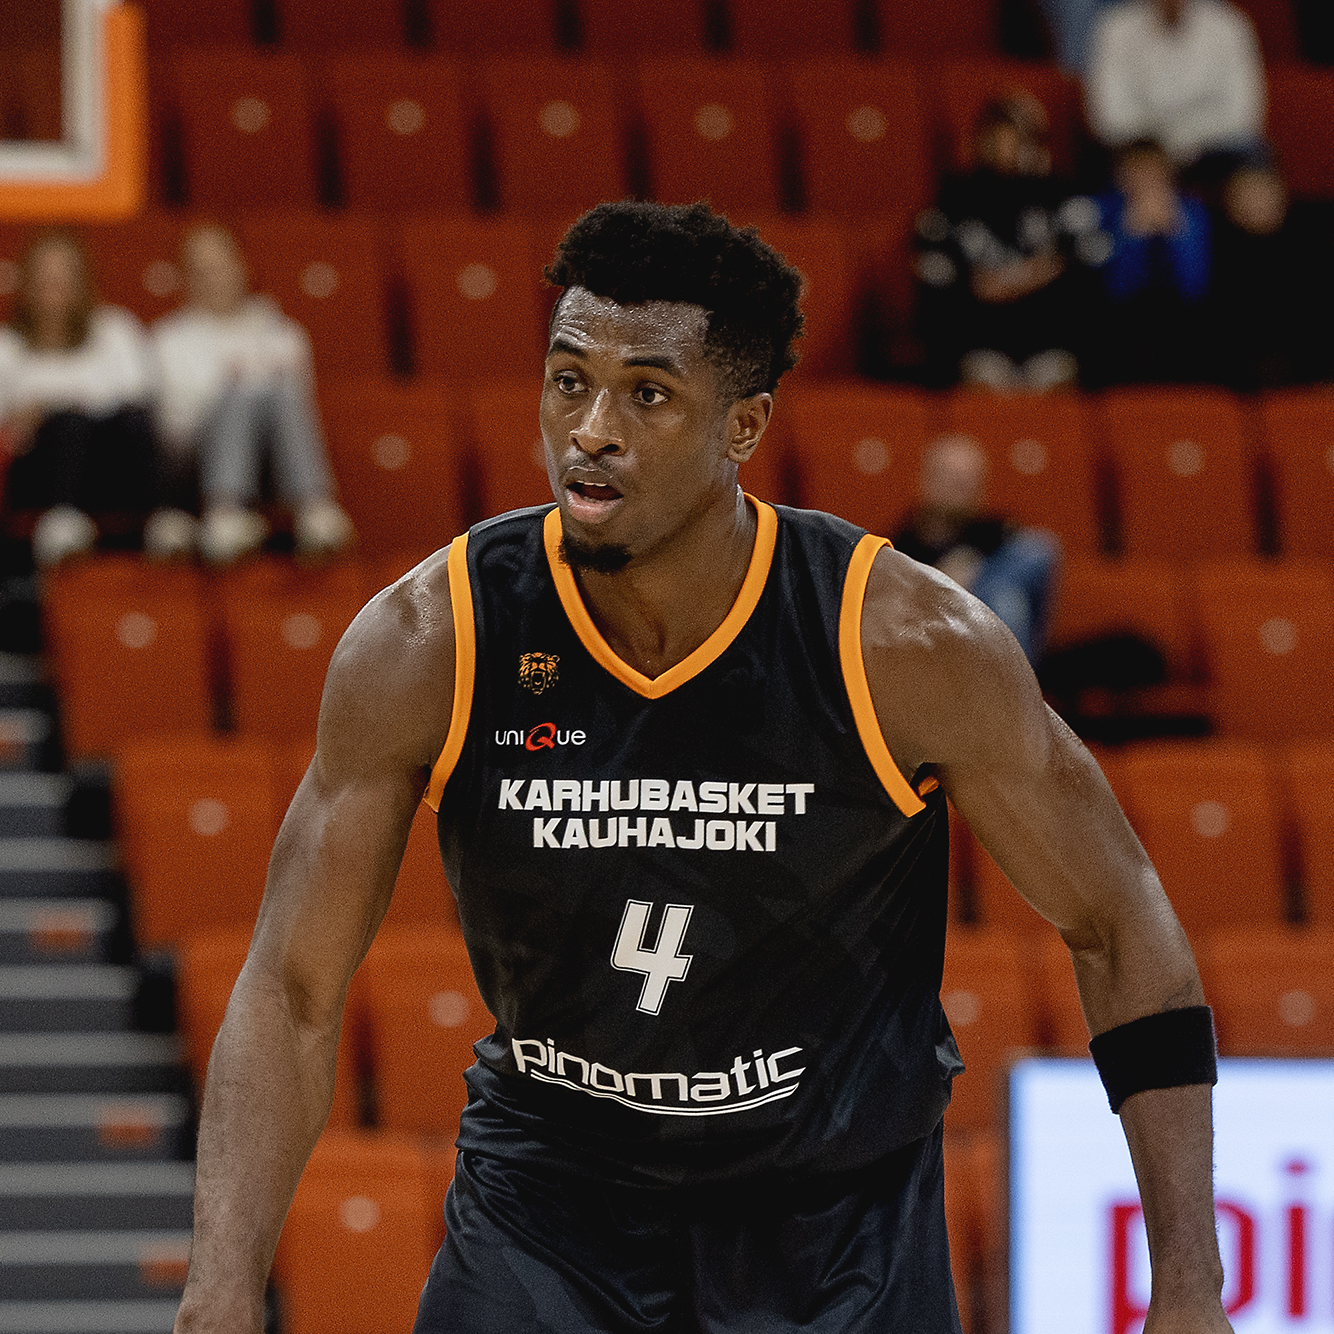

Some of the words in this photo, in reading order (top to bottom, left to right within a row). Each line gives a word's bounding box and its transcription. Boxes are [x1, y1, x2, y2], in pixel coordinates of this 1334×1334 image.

[497, 778, 816, 816] KARHUBASKET
[532, 816, 777, 852] KAUHAJOKI
[610, 898, 694, 1016] 4
[511, 1037, 807, 1102] pinomatic
